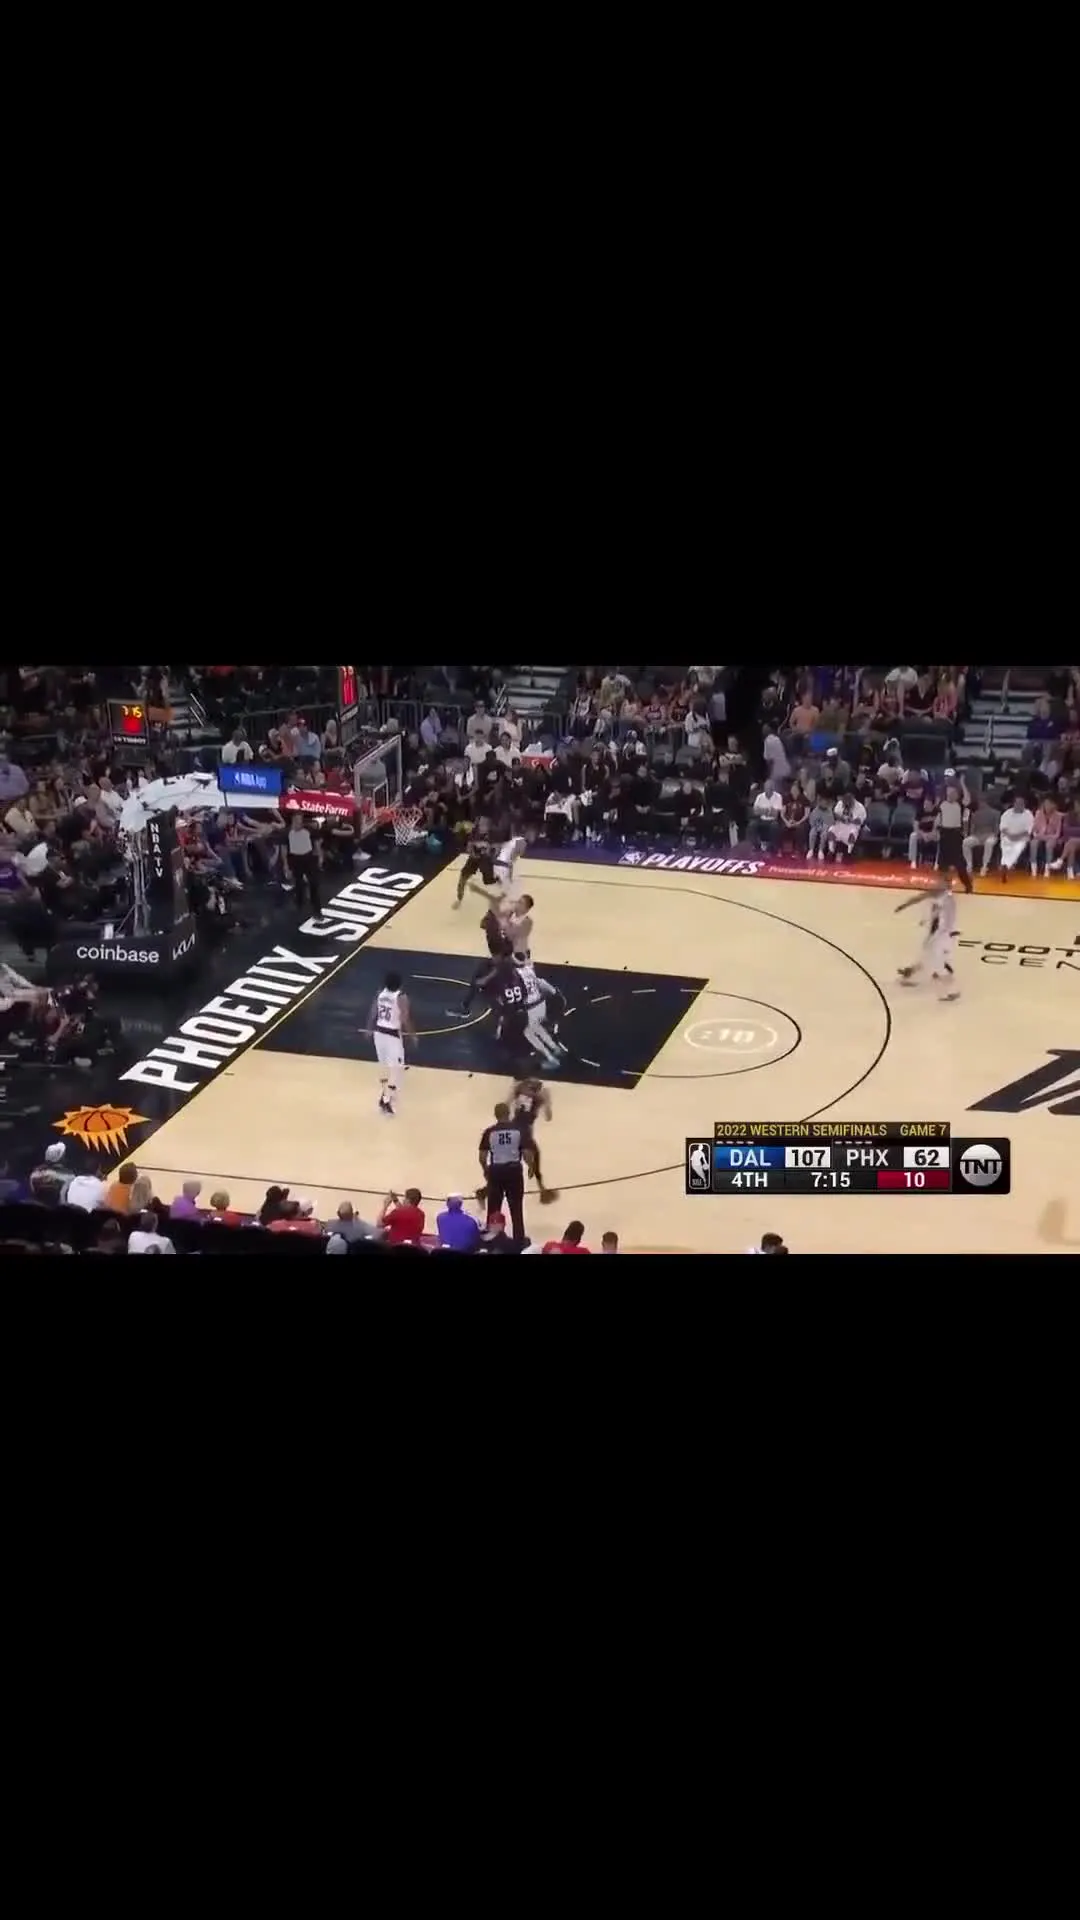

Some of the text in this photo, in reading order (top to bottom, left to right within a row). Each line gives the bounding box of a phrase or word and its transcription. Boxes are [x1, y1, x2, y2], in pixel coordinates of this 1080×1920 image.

[642, 852, 766, 874] PLAYOFFS
[76, 944, 160, 963] coinbase
[118, 867, 424, 1092] PHOENIX SUNS
[505, 986, 522, 1003] 99
